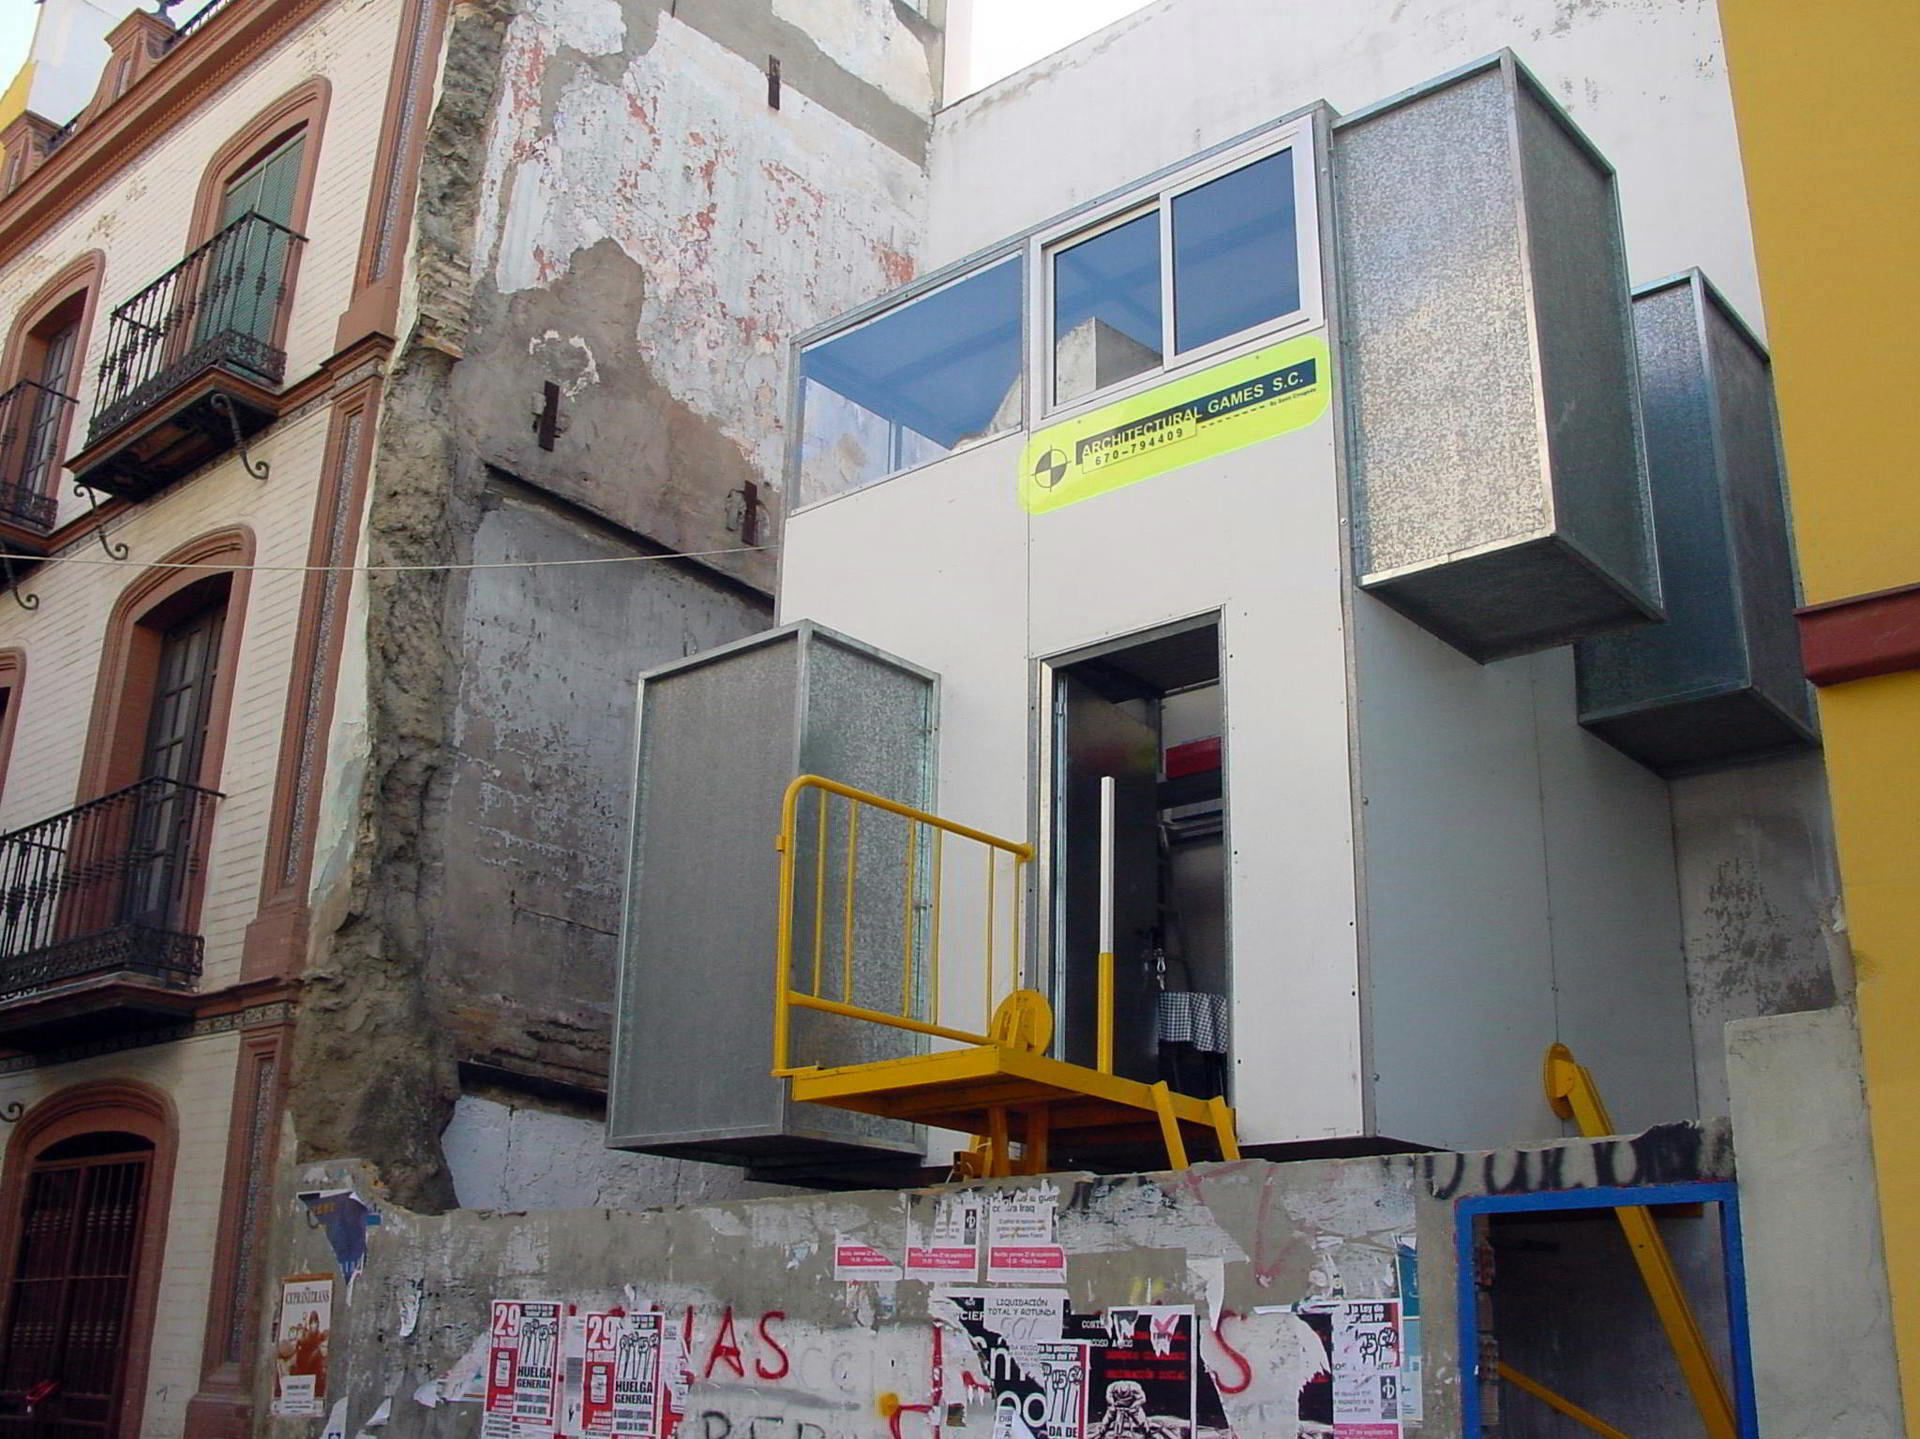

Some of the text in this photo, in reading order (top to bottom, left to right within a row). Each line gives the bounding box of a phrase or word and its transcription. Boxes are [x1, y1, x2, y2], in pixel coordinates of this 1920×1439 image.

[1082, 371, 1304, 456] ARCHITECTURAL GAMES S.C.
[1095, 427, 1183, 466] 670-794409
[995, 1297, 1048, 1307] LIQUIDACIÓN
[988, 1308, 1056, 1316] TOTAL Y ROTUNDA
[494, 1303, 520, 1337] 29
[587, 1315, 618, 1350] 29
[517, 1365, 552, 1378] HUELGA
[516, 1378, 551, 1389] GENERAL
[615, 1380, 653, 1393] HUELGA
[614, 1393, 653, 1405] GENERAL
